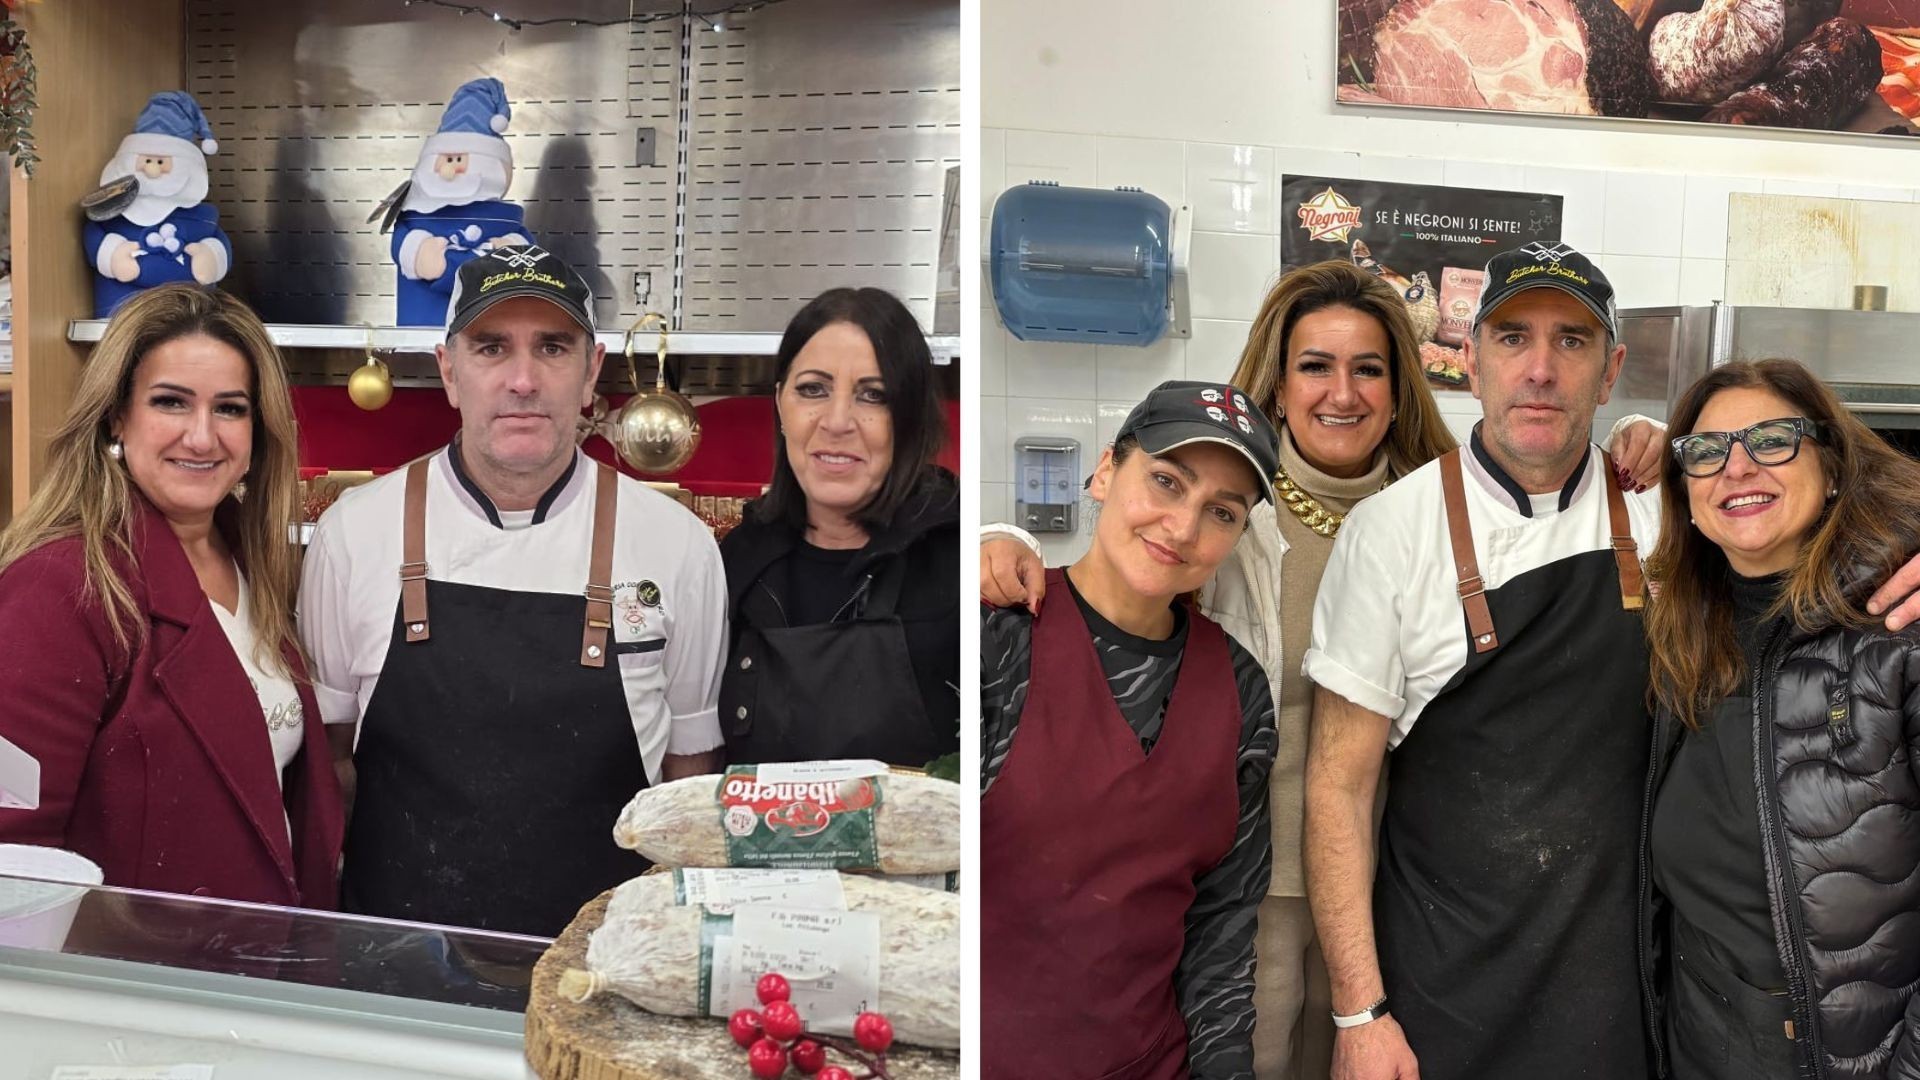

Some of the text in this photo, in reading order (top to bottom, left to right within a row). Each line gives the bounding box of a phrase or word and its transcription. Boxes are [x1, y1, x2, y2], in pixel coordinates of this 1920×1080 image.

[1298, 206, 1363, 238] Negroni
[1375, 209, 1522, 234] SE È NEGRONI SI SENTE!
[1415, 232, 1483, 245] 100% ITALIANO
[479, 267, 567, 293] Butcher Brothers
[1505, 261, 1589, 286] Butcher Brothers
